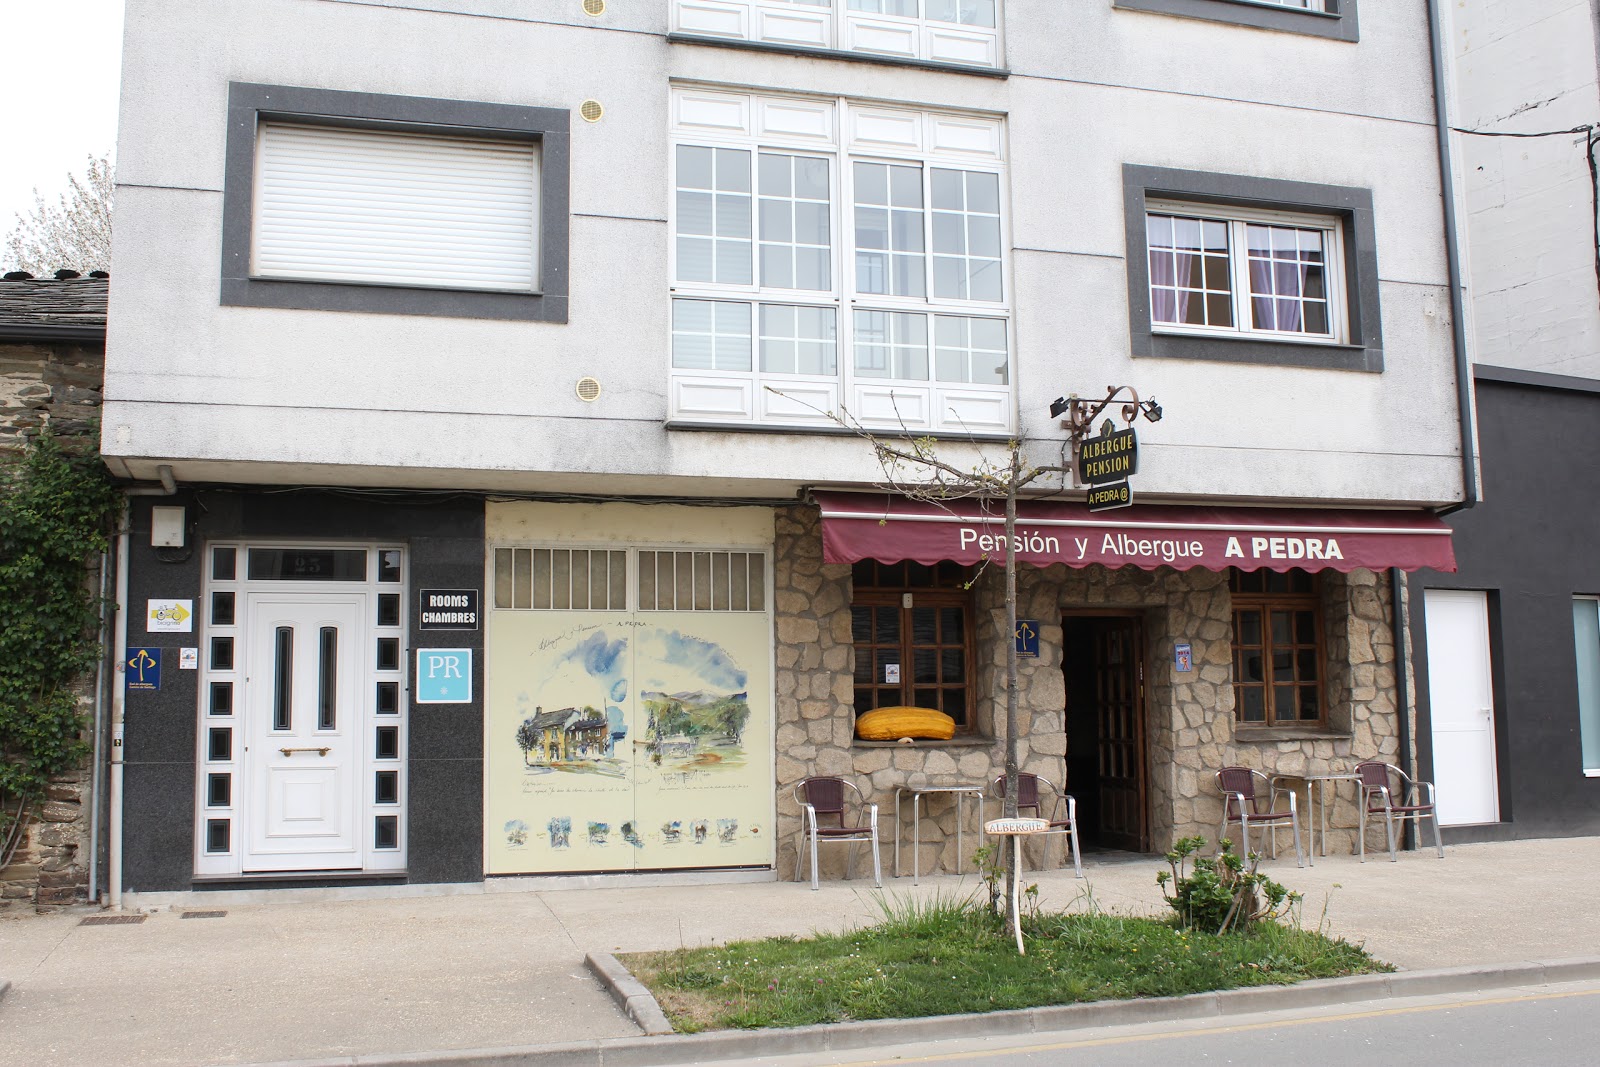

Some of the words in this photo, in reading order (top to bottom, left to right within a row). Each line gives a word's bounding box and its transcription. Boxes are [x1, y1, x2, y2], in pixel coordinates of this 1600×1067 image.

[1083, 434, 1133, 460] ALBERGUE
[1086, 455, 1129, 478] PENSION
[1089, 493, 1094, 504] A
[1095, 489, 1119, 503] PEDRA
[960, 528, 1060, 554] Pensión
[1074, 536, 1089, 560] y
[1101, 533, 1204, 562] Albergue
[1225, 536, 1244, 558] A
[1251, 537, 1344, 560] PEDRA
[429, 595, 469, 607] ROOMS
[422, 612, 476, 624] CHAMBRES
[428, 655, 462, 679] PR
[989, 821, 1043, 832] ALBERGUE
